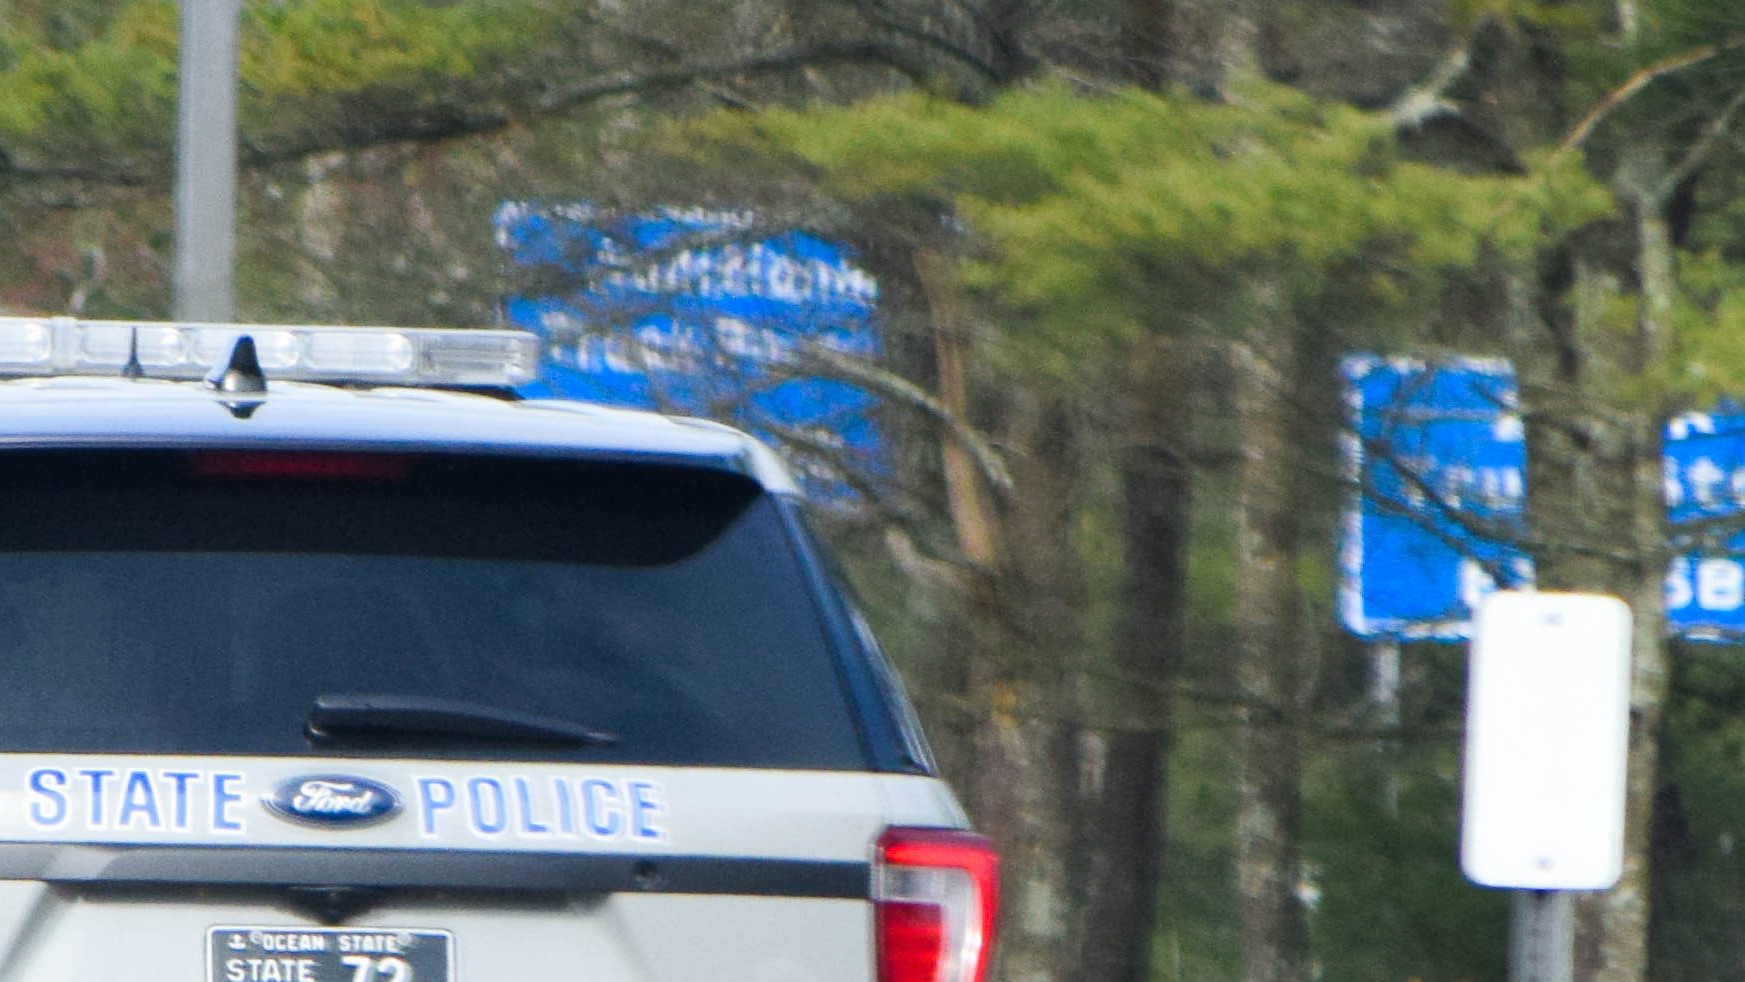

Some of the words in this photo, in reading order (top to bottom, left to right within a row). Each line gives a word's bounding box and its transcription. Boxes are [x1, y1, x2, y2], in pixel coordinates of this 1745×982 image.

[28, 768, 244, 832] STATE
[292, 780, 374, 814] Ford
[417, 776, 663, 838] POLICE
[263, 934, 325, 951] OCEAN
[338, 935, 398, 952] STATE
